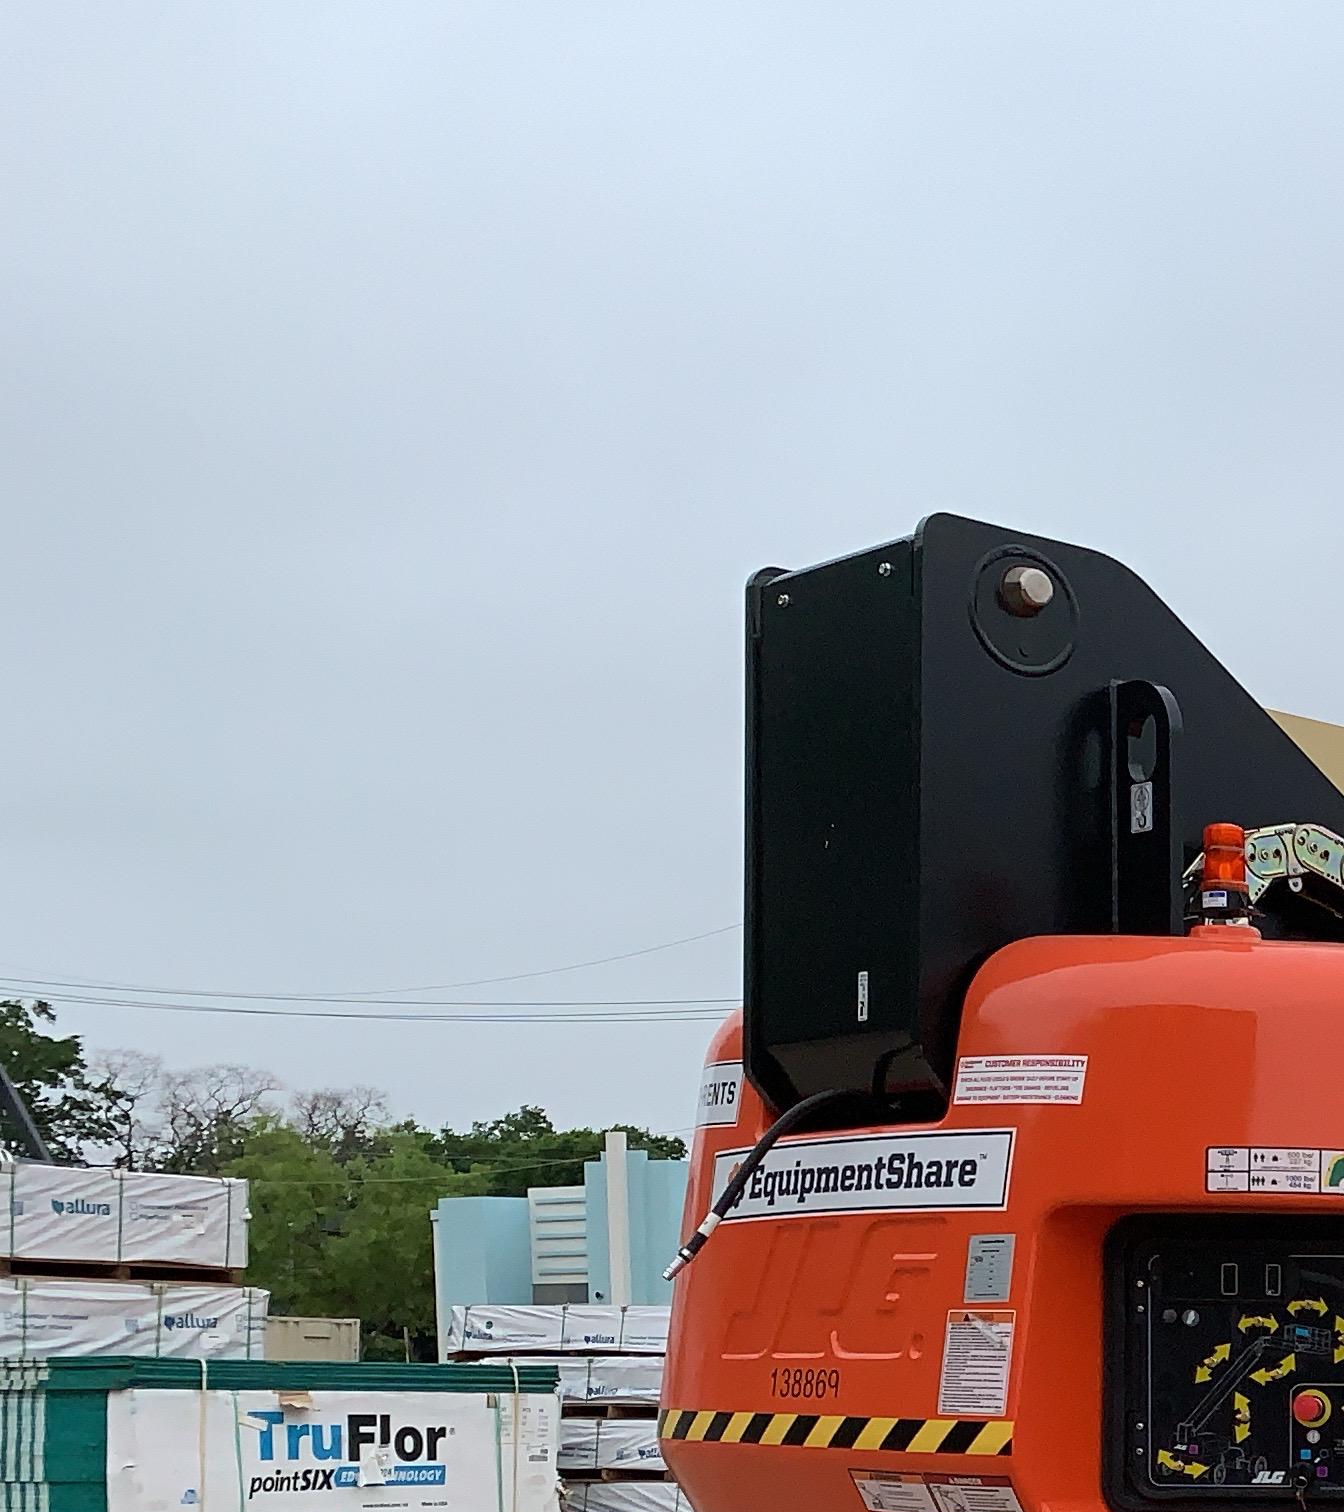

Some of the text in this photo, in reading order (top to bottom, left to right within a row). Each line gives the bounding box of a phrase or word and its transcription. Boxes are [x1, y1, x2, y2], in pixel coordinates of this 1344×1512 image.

[748, 1152, 978, 1206] EquipmentShare
[65, 1199, 111, 1216] allura
[176, 1313, 219, 1330] allura
[770, 1367, 840, 1399] 138869
[247, 1411, 447, 1462] TruFlor
[249, 1469, 335, 1500] pointSIX
[1251, 1470, 1286, 1484] JLG
